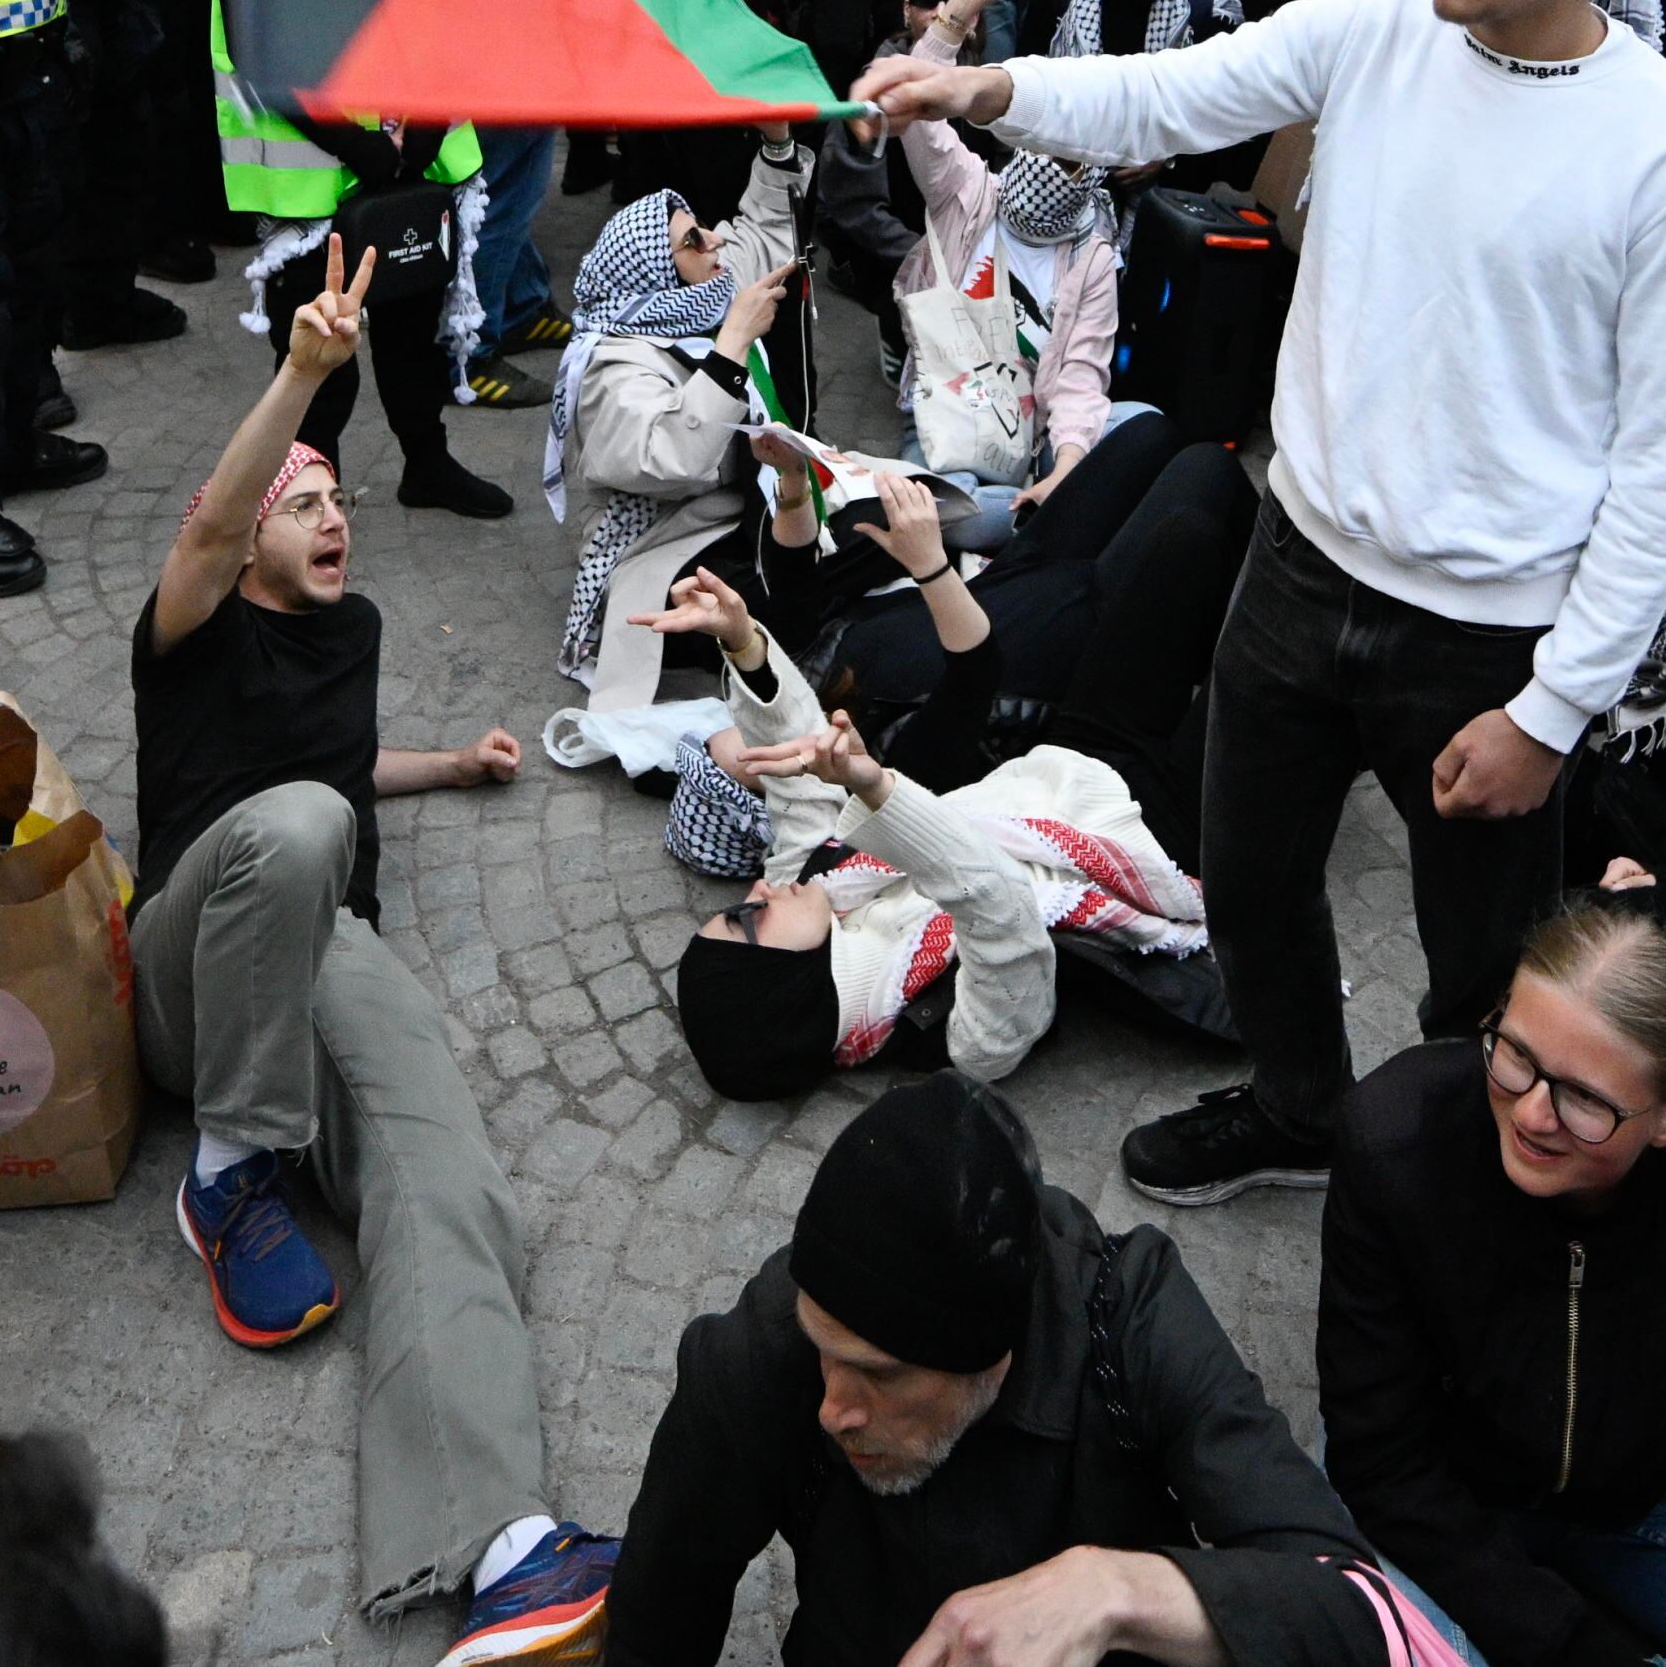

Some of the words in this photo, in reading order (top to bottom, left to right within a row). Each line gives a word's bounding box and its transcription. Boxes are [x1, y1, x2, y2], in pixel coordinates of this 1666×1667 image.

[1508, 60, 1581, 80] Angels
[388, 247, 408, 259] FIRST
[409, 245, 421, 254] AID
[422, 242, 433, 251] KIT
